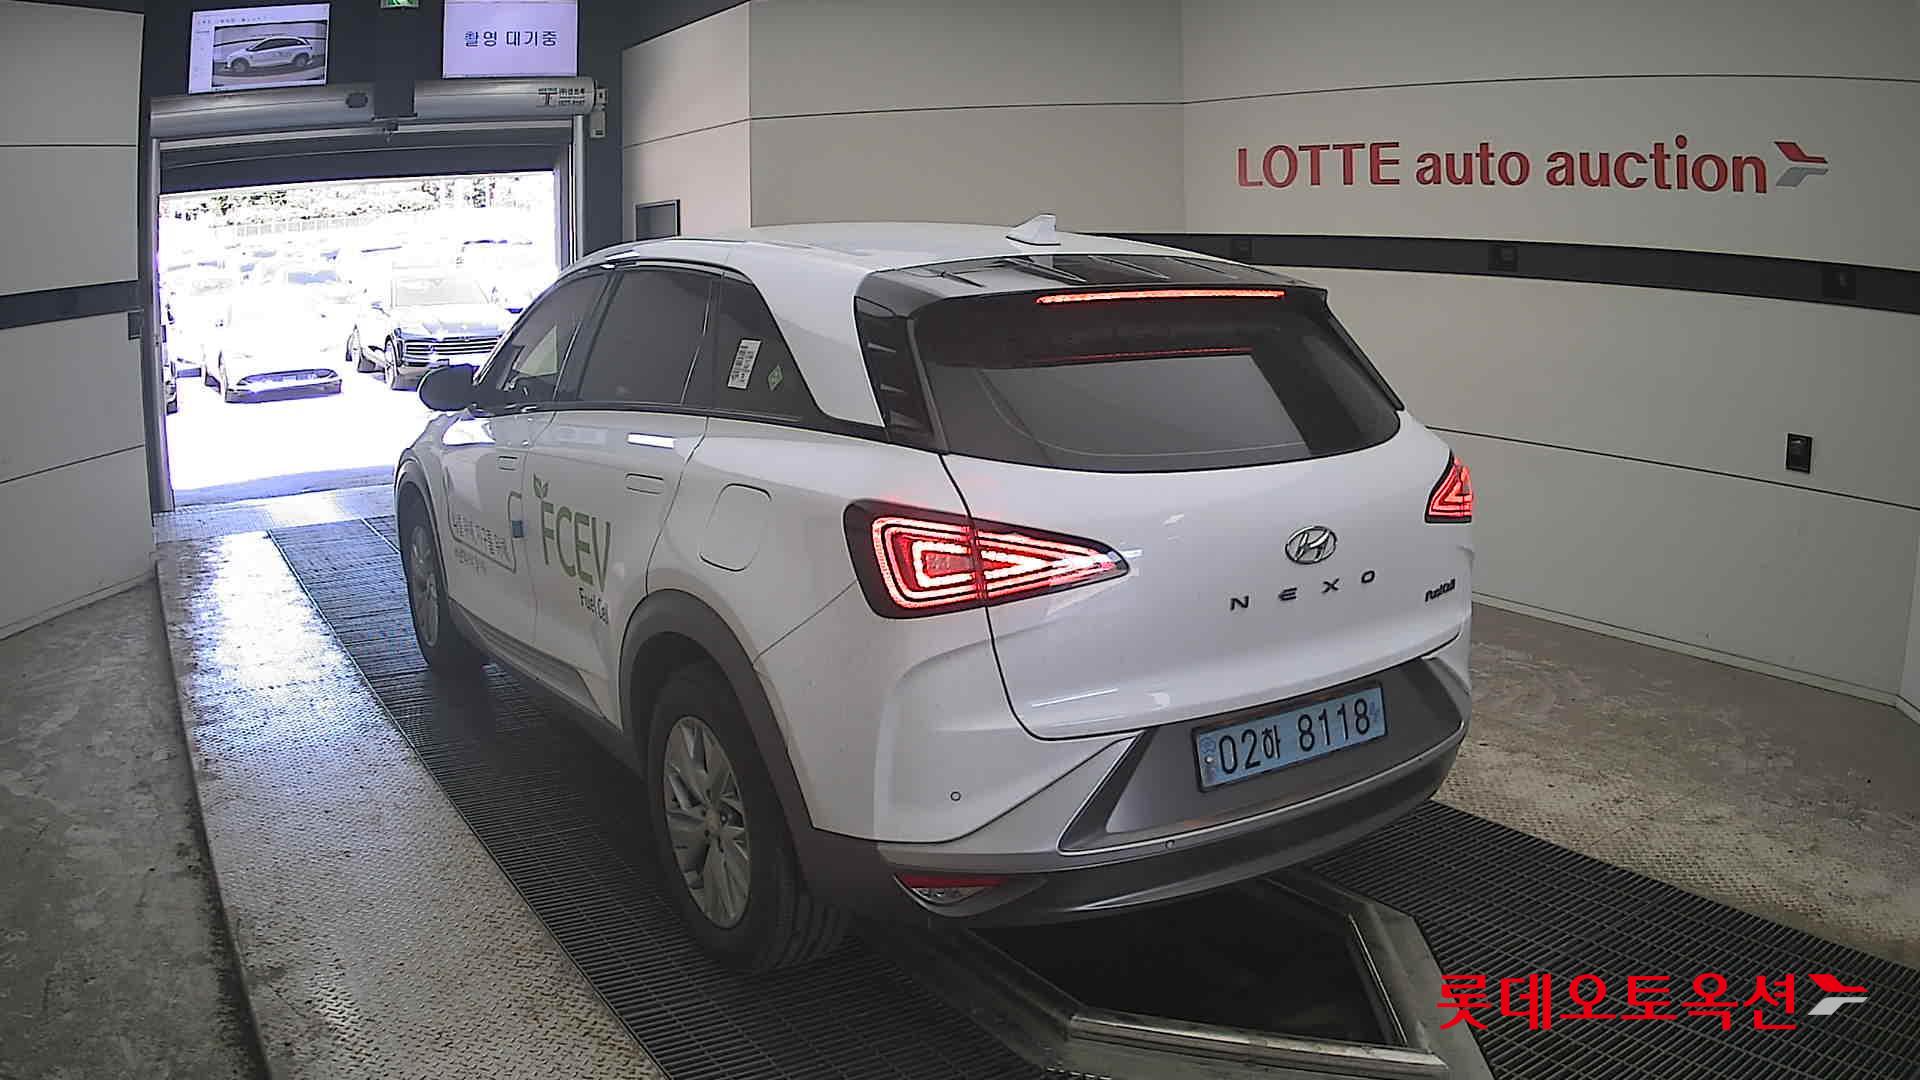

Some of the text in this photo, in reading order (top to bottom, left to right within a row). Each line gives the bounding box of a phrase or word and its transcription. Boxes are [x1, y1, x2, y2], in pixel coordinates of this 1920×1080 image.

[505, 30, 559, 47] 대기중
[1238, 134, 1768, 194] LOTTE auto auction
[540, 499, 612, 593] FCEV
[1229, 569, 1376, 611] NEXO
[1218, 698, 1371, 775] 02하 8118
